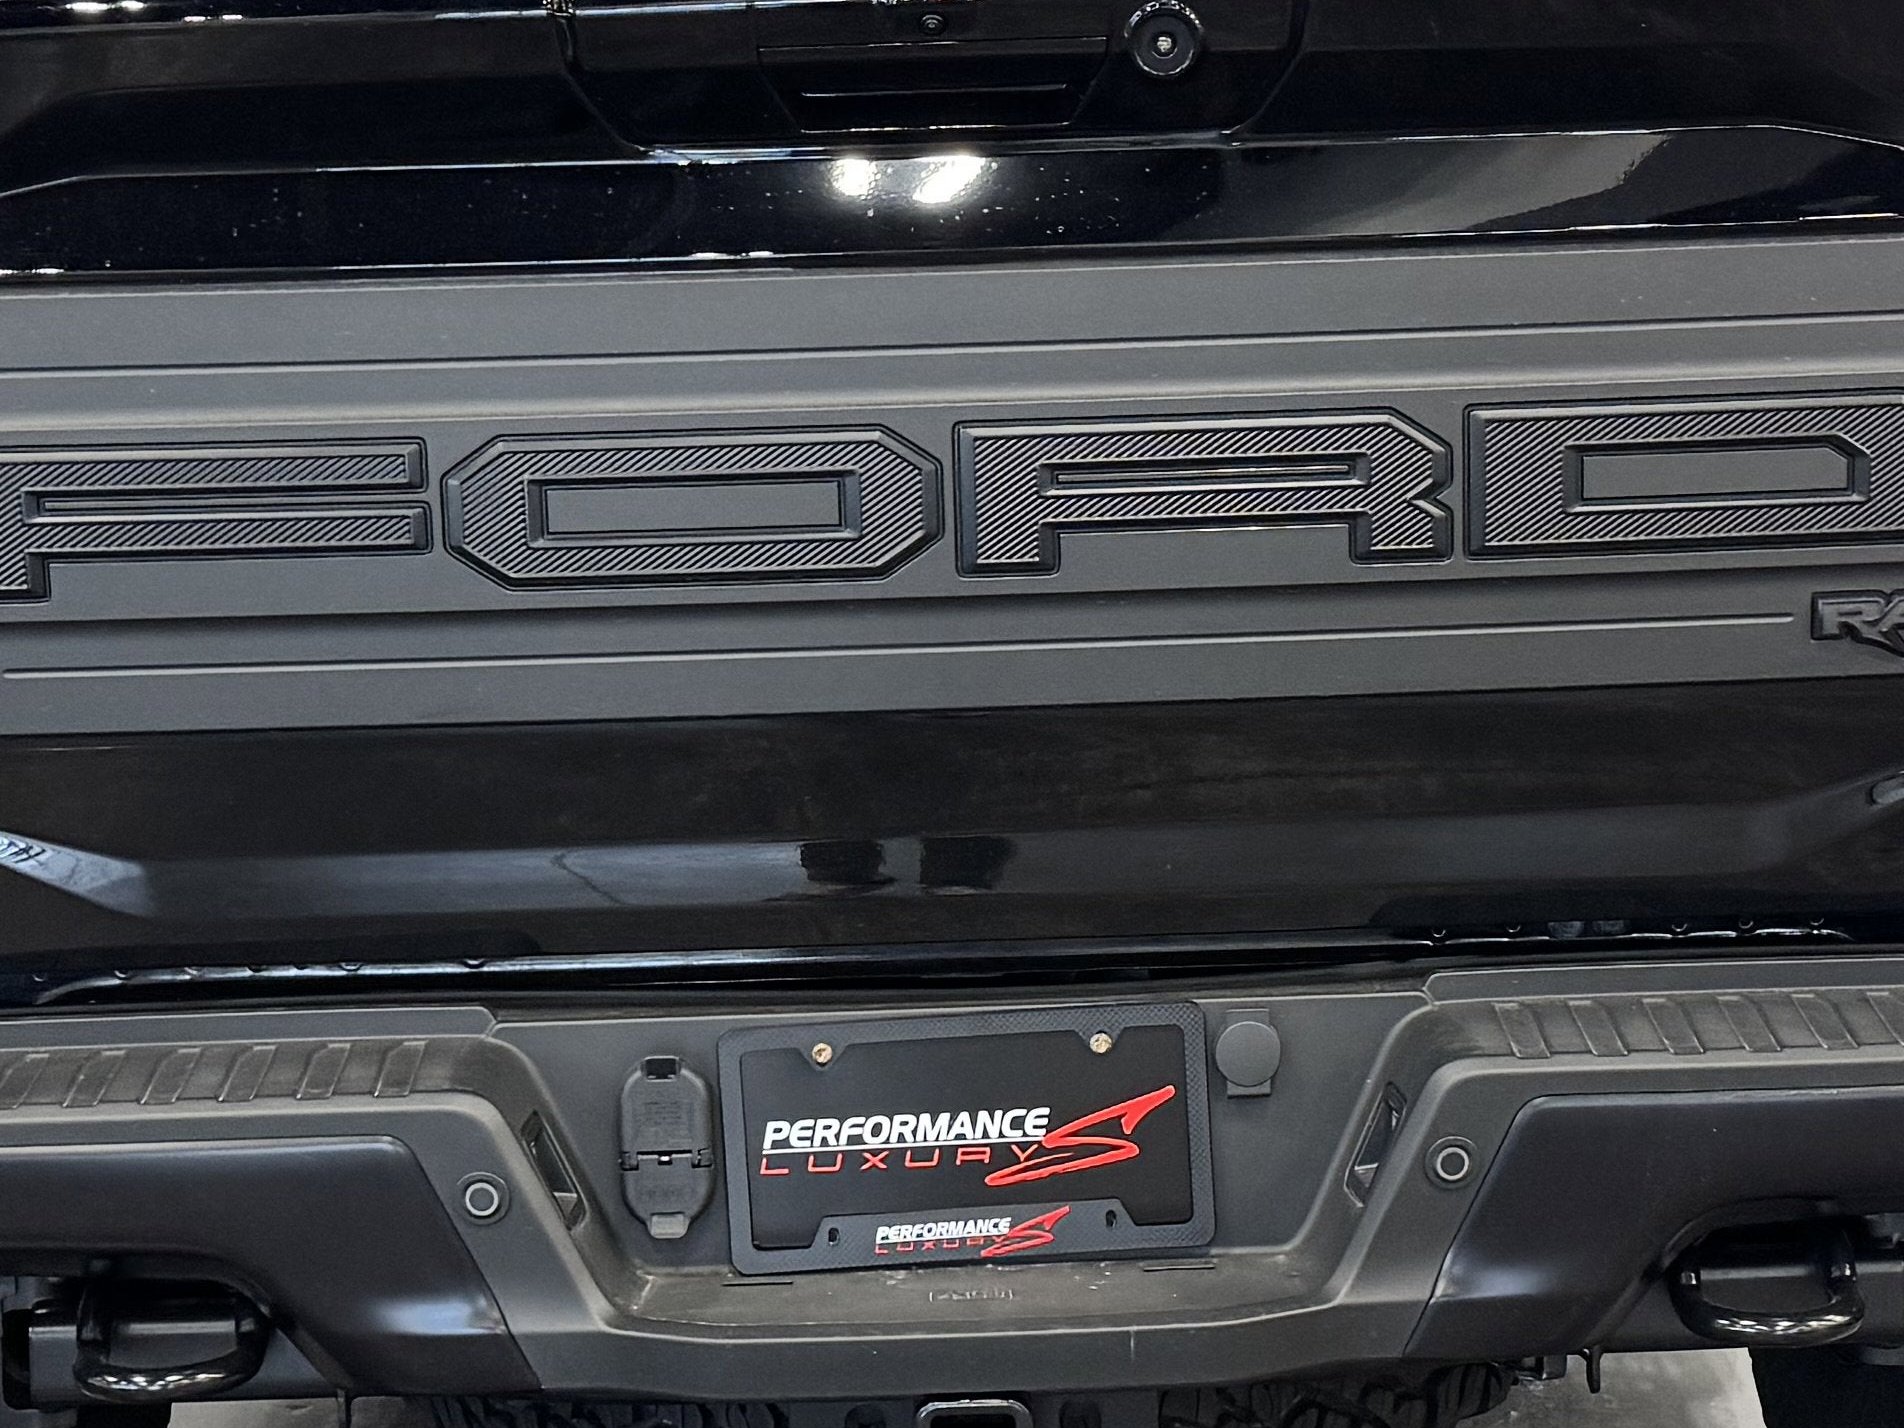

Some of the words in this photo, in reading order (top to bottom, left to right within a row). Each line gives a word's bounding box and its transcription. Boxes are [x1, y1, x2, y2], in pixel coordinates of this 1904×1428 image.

[762, 1107, 1050, 1149] PERFORMANCE
[759, 1144, 1038, 1175] LUXURY
[875, 1217, 1012, 1242] PERFORMANCE
